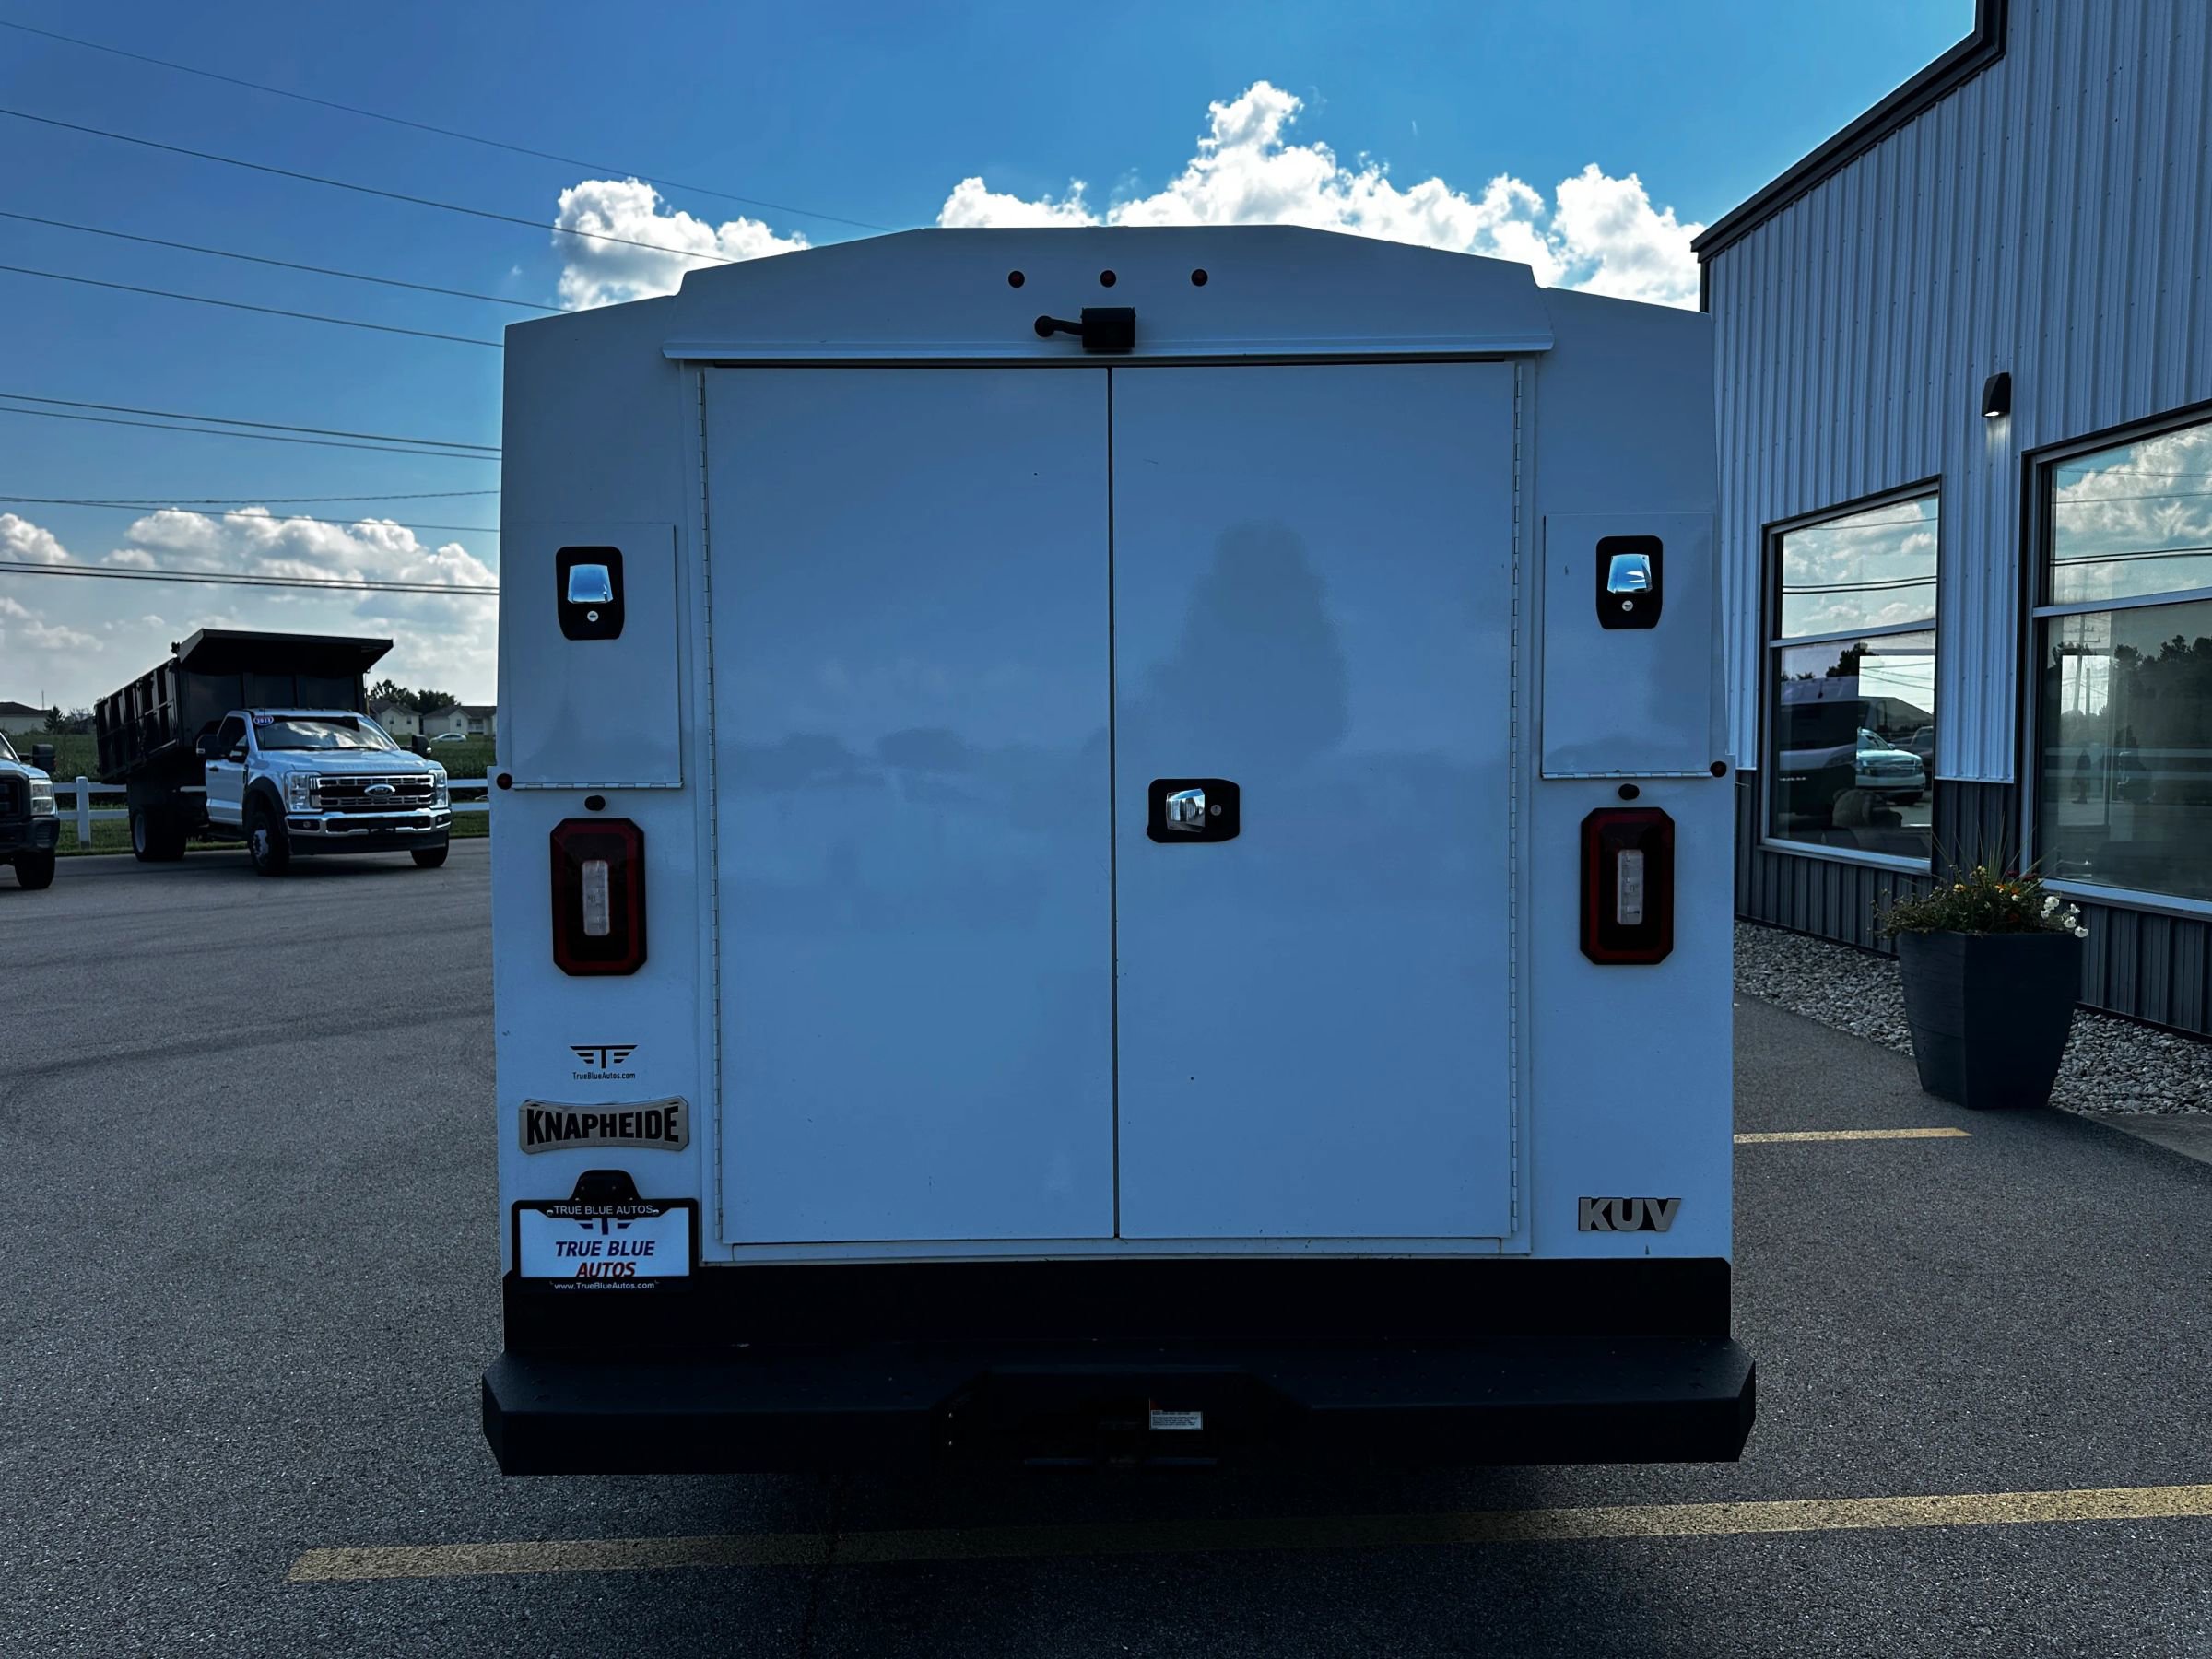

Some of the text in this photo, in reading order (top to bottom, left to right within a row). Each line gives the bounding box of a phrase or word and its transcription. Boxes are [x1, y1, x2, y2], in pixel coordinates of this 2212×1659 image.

[572, 1072, 636, 1080] TrueBlueAutos.com
[526, 1106, 679, 1146] KNAPHEIDE
[553, 1205, 653, 1215] TRUE BLUE AUTOS
[1578, 1196, 1682, 1232] KUV
[555, 1241, 656, 1257] TRUE BLUE
[574, 1261, 637, 1278] AUTOS
[554, 1282, 655, 1290] www.TrueBlueAutos.com
